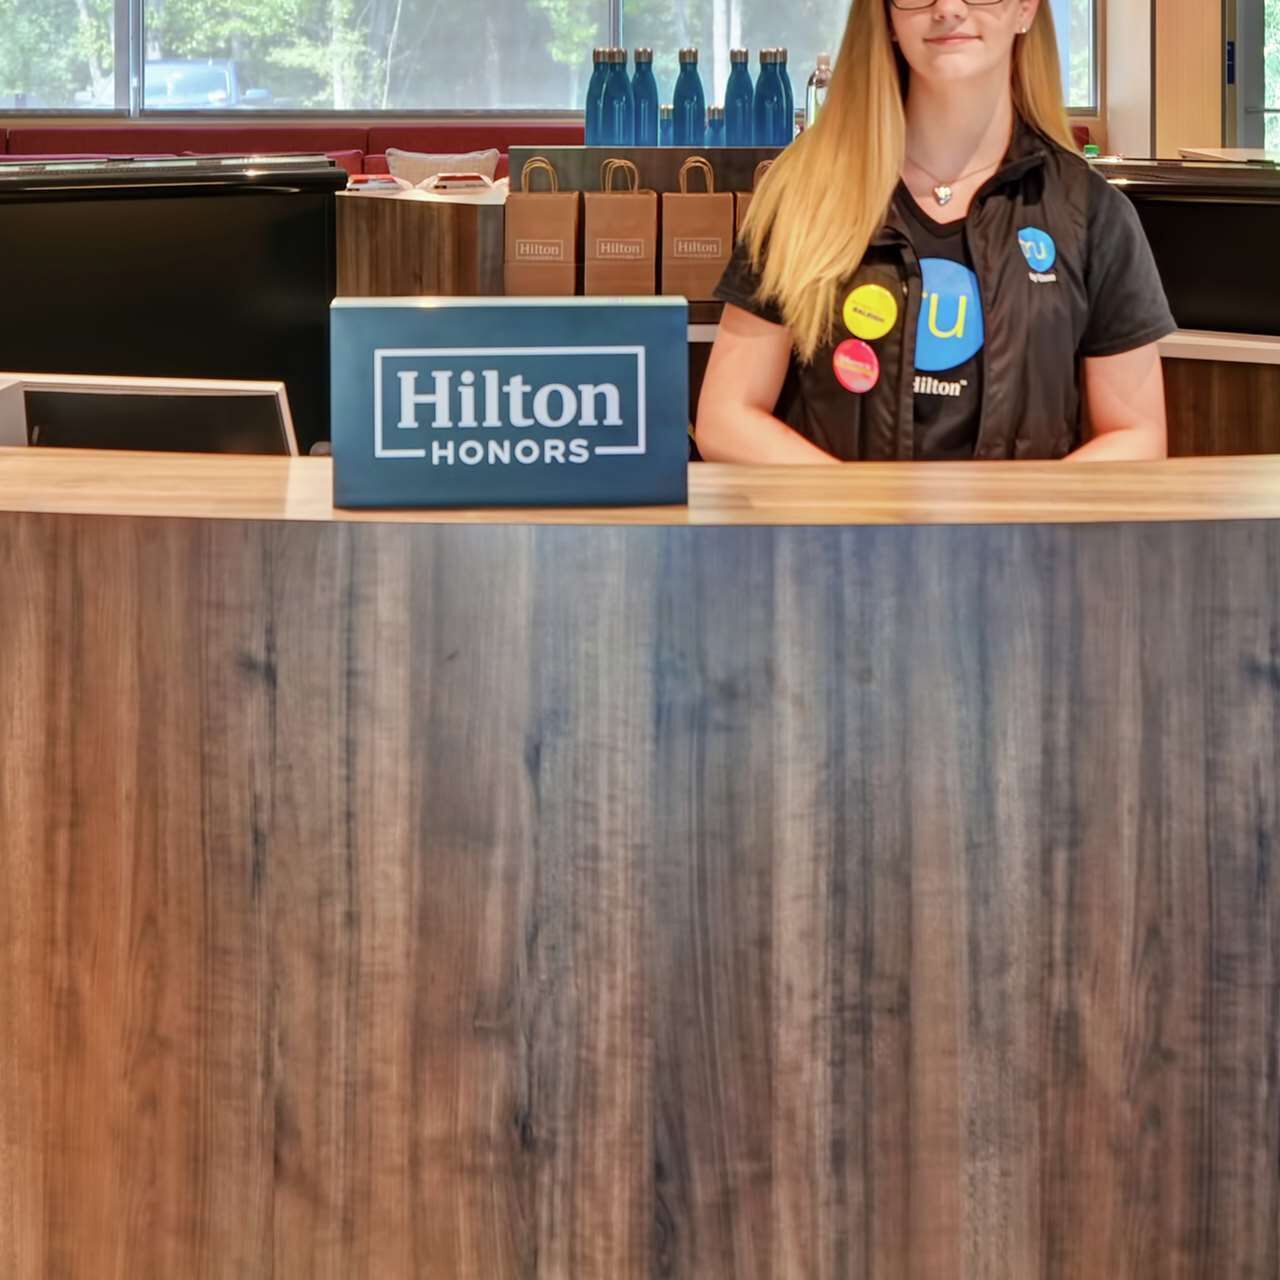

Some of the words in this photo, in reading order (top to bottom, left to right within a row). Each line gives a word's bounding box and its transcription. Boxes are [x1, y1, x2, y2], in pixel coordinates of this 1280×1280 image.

[519, 243, 559, 256] Hilton
[600, 241, 641, 254] Hilton
[677, 240, 718, 253] Hilton
[397, 370, 624, 428] Hilton
[431, 437, 590, 465] HONORS
